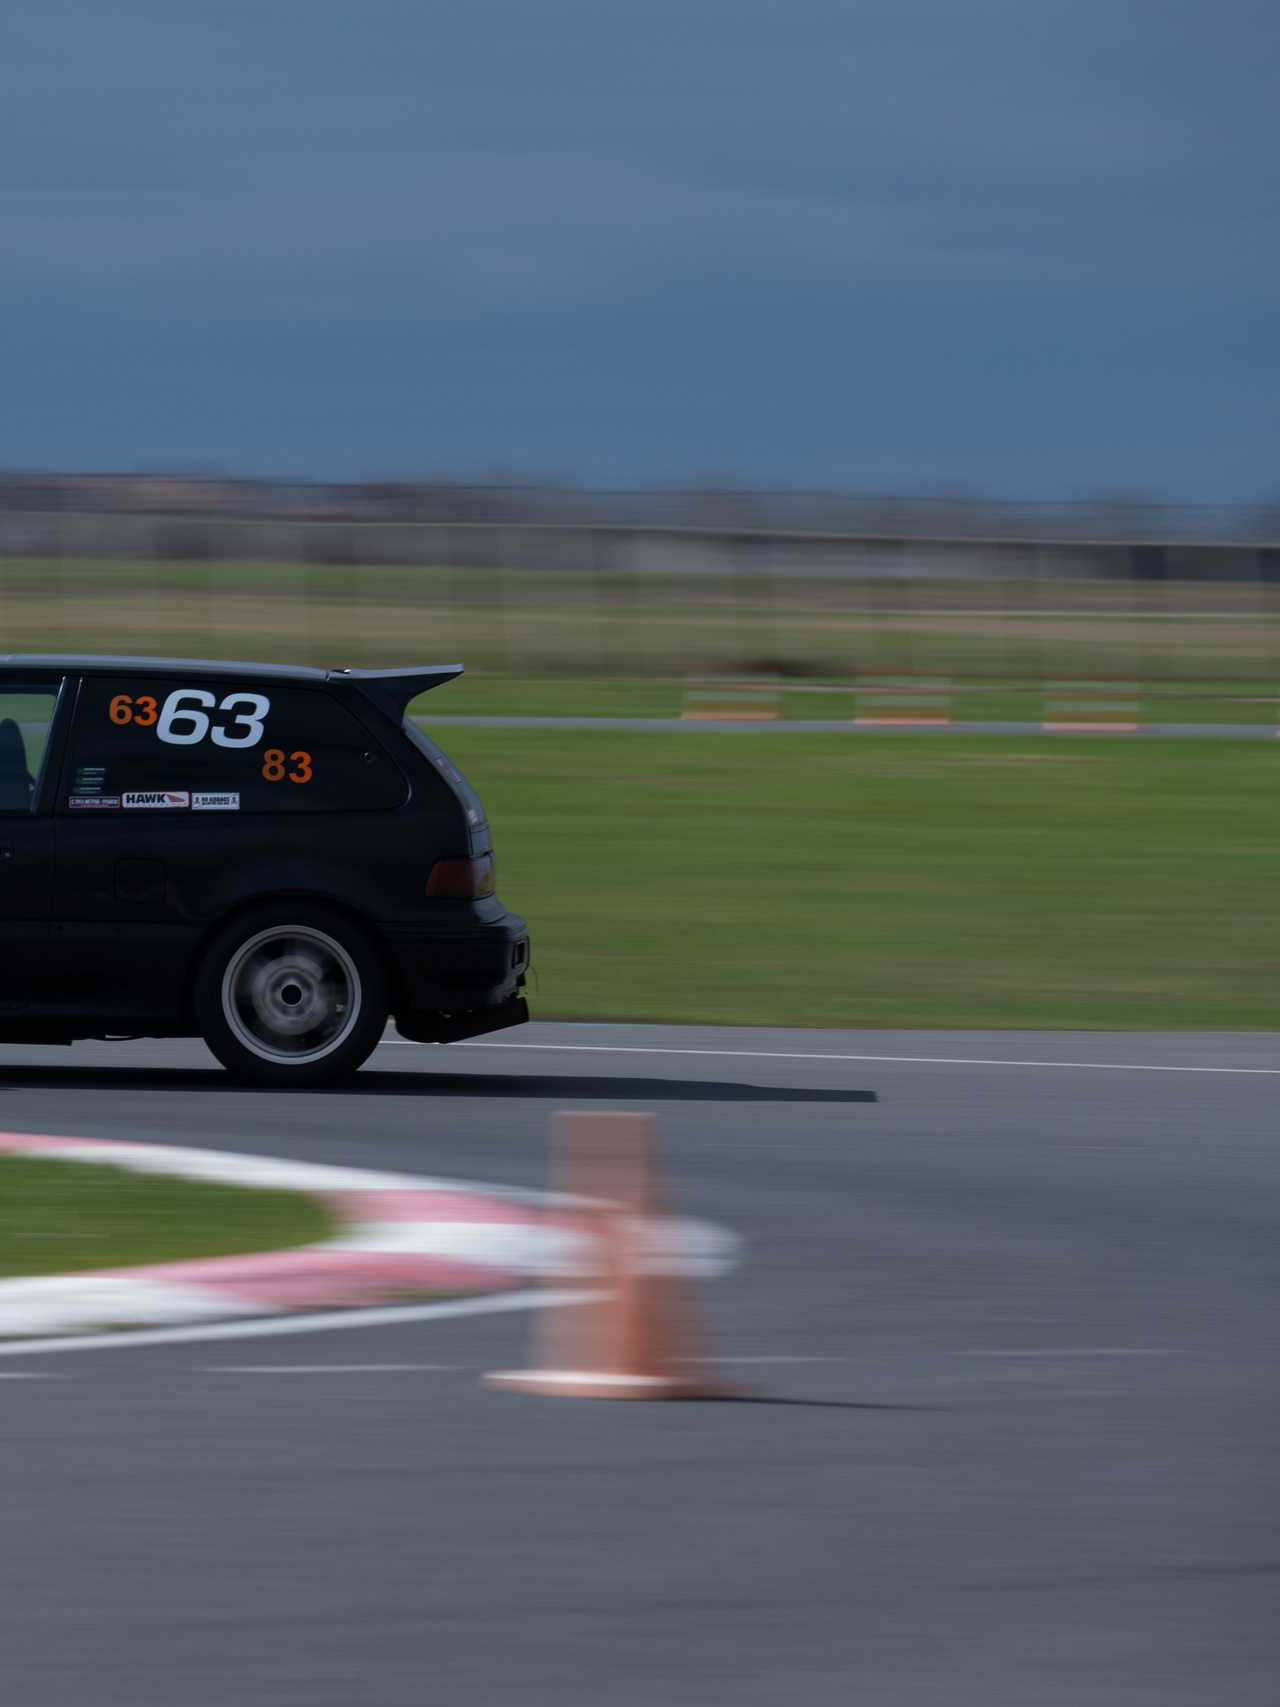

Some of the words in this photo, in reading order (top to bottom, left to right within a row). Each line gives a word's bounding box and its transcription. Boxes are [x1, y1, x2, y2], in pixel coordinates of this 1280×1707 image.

[109, 694, 158, 726] 63
[156, 688, 271, 749] 63
[261, 748, 313, 784] 83
[126, 793, 166, 803] HAWK
